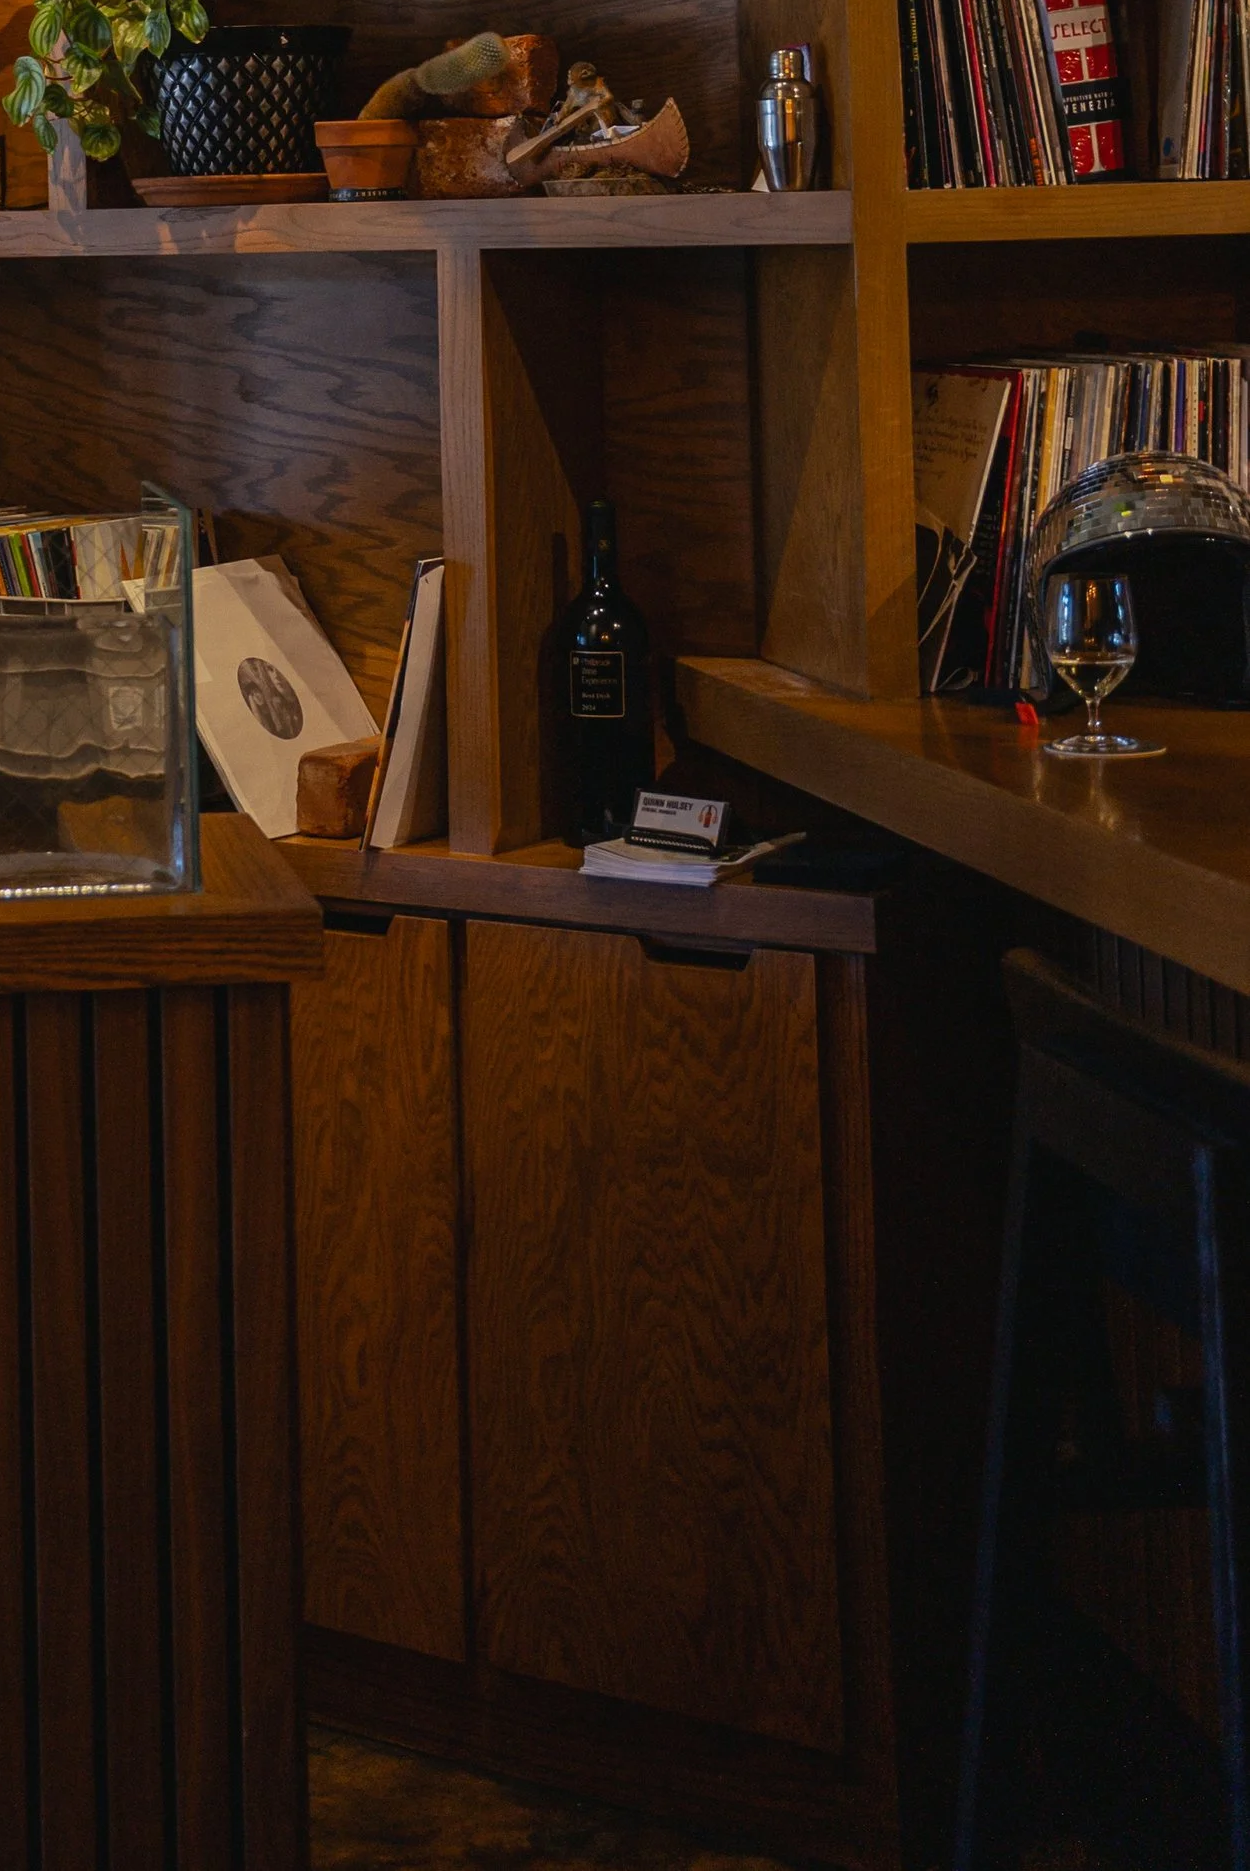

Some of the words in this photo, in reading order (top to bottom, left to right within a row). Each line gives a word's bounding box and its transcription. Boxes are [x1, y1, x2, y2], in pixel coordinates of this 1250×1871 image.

[1051, 18, 1107, 40] SELECT
[1062, 97, 1116, 116] VENEZIA
[666, 800, 694, 811] HULSEY
